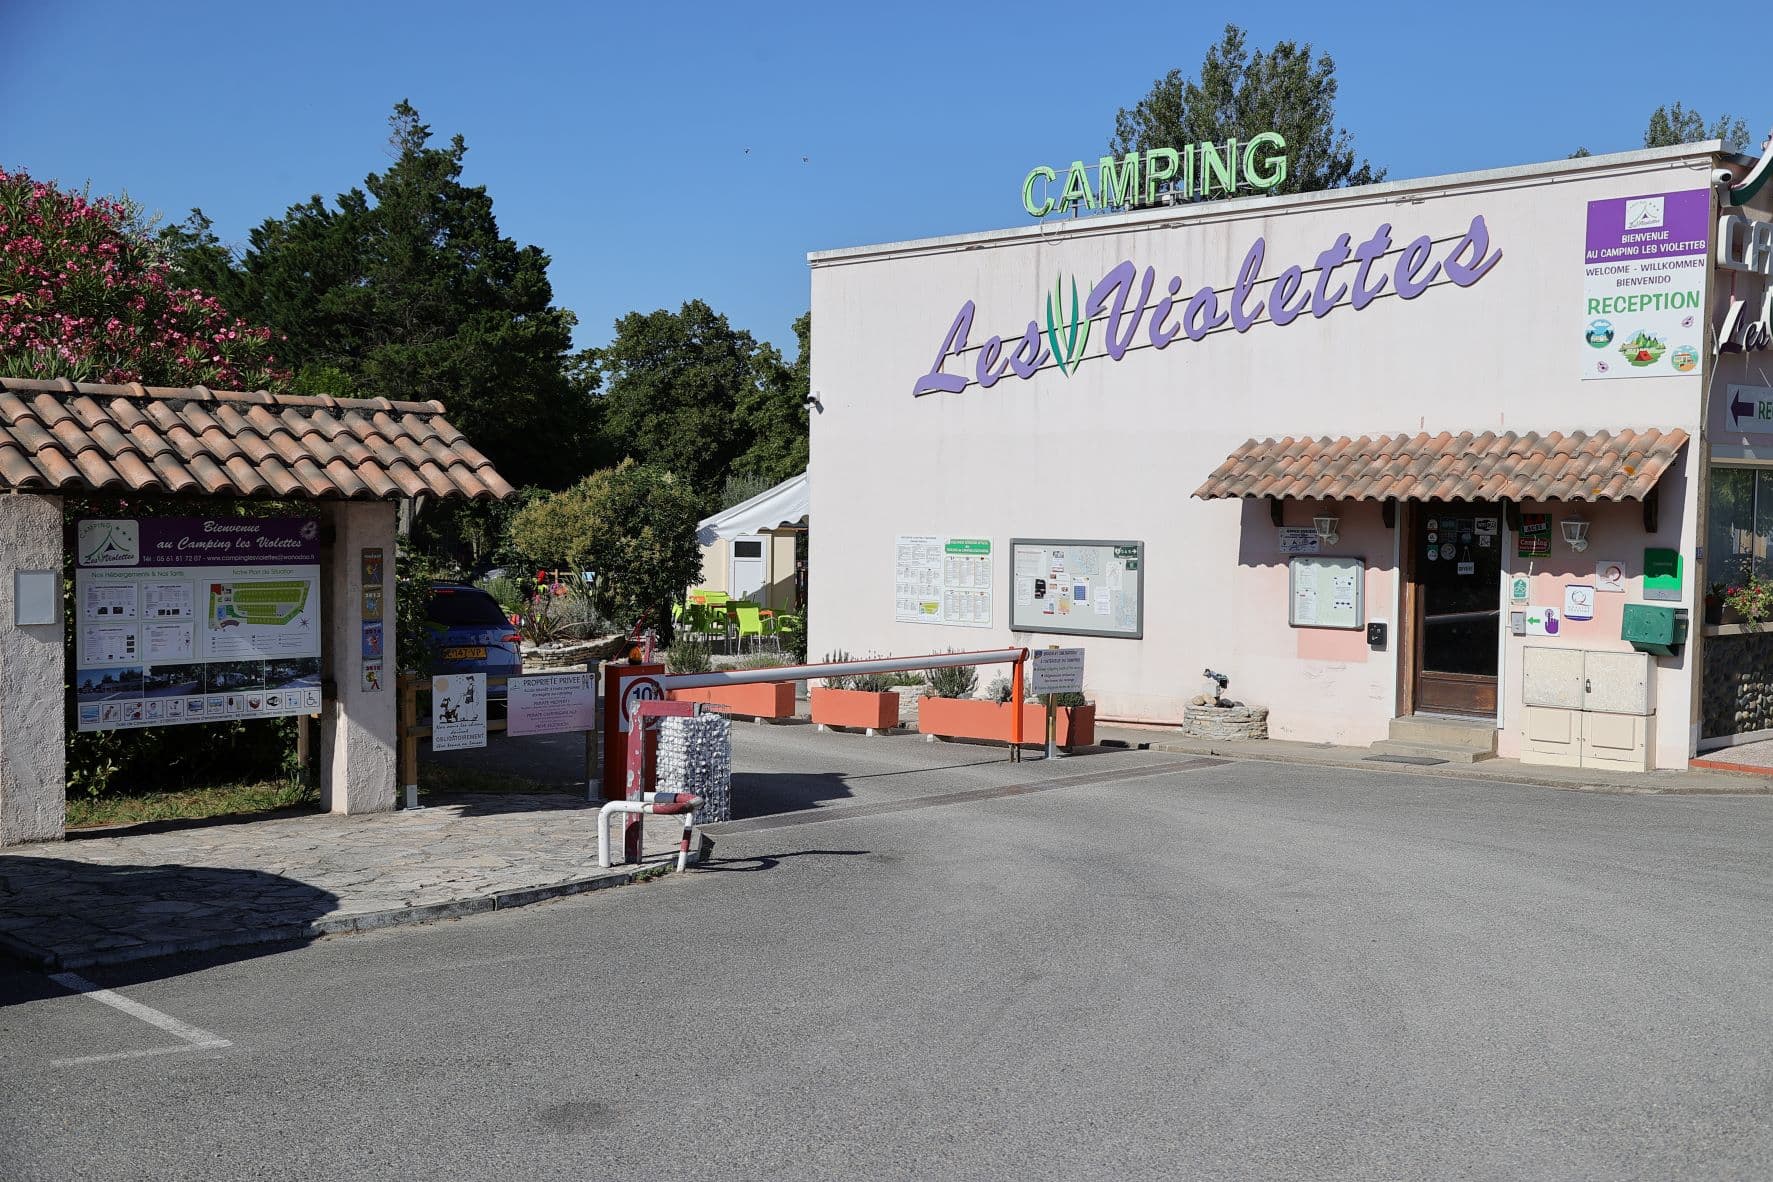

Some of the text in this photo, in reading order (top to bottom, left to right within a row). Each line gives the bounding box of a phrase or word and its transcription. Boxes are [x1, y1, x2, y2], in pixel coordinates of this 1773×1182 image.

[1022, 131, 1288, 217] CAMPING
[1621, 230, 1670, 244] BIENVENUE
[1586, 240, 1706, 259] AU CAMPING LES VIOLETTES
[1585, 265, 1631, 277] WELCOME
[1640, 259, 1705, 272] WILLKOMMEN
[1616, 274, 1671, 288] BIENVENIDO
[913, 214, 1502, 397] Les Violettes
[1587, 290, 1700, 316] RECEPTION
[1758, 400, 1773, 420] RE
[203, 520, 260, 533] Bienvenue
[156, 536, 302, 552] au Camping les Violettes
[632, 686, 653, 700] 10
